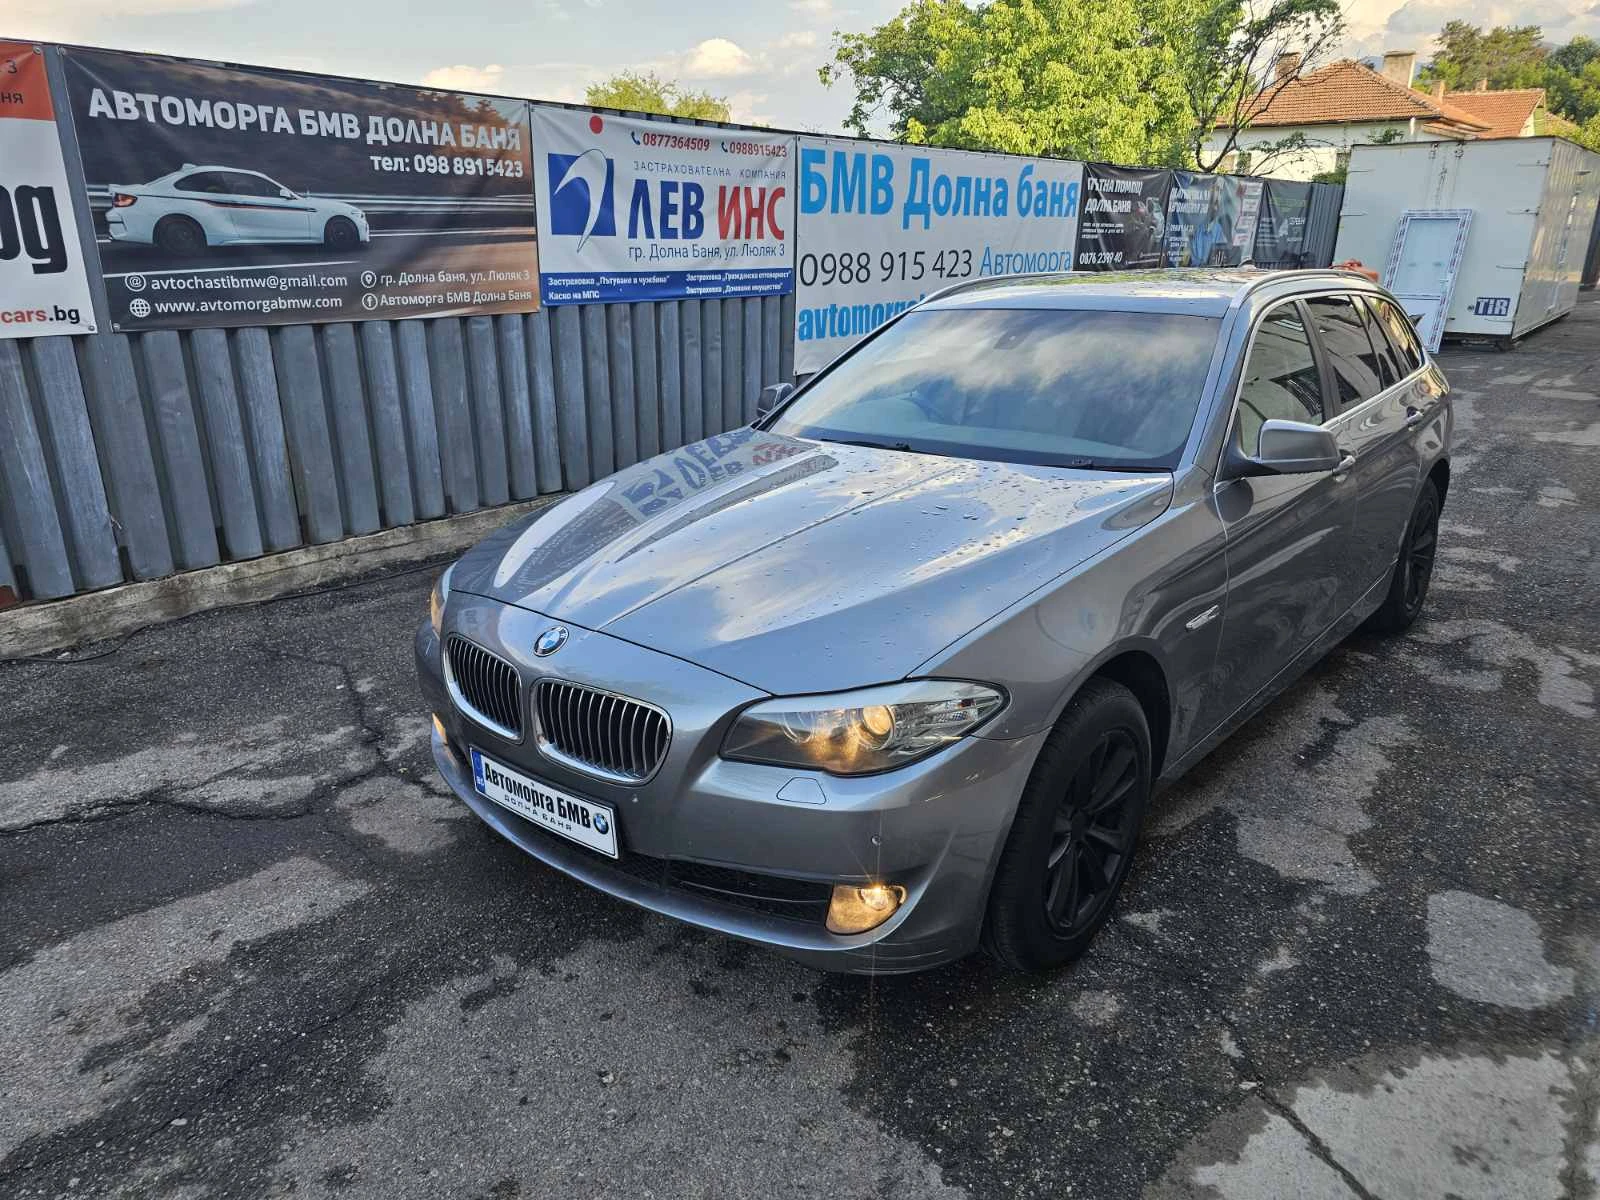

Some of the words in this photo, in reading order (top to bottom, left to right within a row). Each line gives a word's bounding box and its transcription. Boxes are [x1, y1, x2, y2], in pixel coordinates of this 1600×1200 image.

[88, 88, 295, 134] АВТОМОРГА
[299, 109, 360, 139] БМВ
[366, 116, 456, 146] ДОЛНА
[460, 124, 521, 150] БАНЯ
[642, 132, 710, 151] 0877364509
[729, 141, 788, 158] 0988915423
[370, 155, 410, 172] тел:
[413, 154, 450, 174] 098
[633, 160, 731, 176] ЗАСТРАХОВАТЕЛНА
[739, 168, 786, 180] КОМПАНИЯ
[799, 148, 894, 215] БМВ
[902, 157, 1009, 230] Долна
[1016, 164, 1080, 218] баня
[627, 178, 705, 240] ЛЕВ
[717, 184, 786, 241] ИНС
[629, 246, 646, 262] гр.
[649, 244, 688, 262] Долна
[692, 244, 722, 260] Баня,
[725, 246, 738, 260] ул.
[741, 244, 776, 257] Люляк
[779, 243, 785, 257] 3
[799, 252, 871, 286] 0988
[880, 251, 925, 282] 915
[932, 249, 972, 279] 423
[979, 246, 1072, 276] Автоморга
[151, 274, 348, 290] avtochastibmw@gmail.com
[398, 272, 435, 286] Долна
[155, 297, 343, 312] www.avtomorgabmw.com
[380, 294, 444, 306] Автоморга
[447, 292, 470, 303] БМВ
[473, 291, 506, 304] Долна
[508, 290, 532, 301] Баня
[556, 796, 591, 829] БМВ
